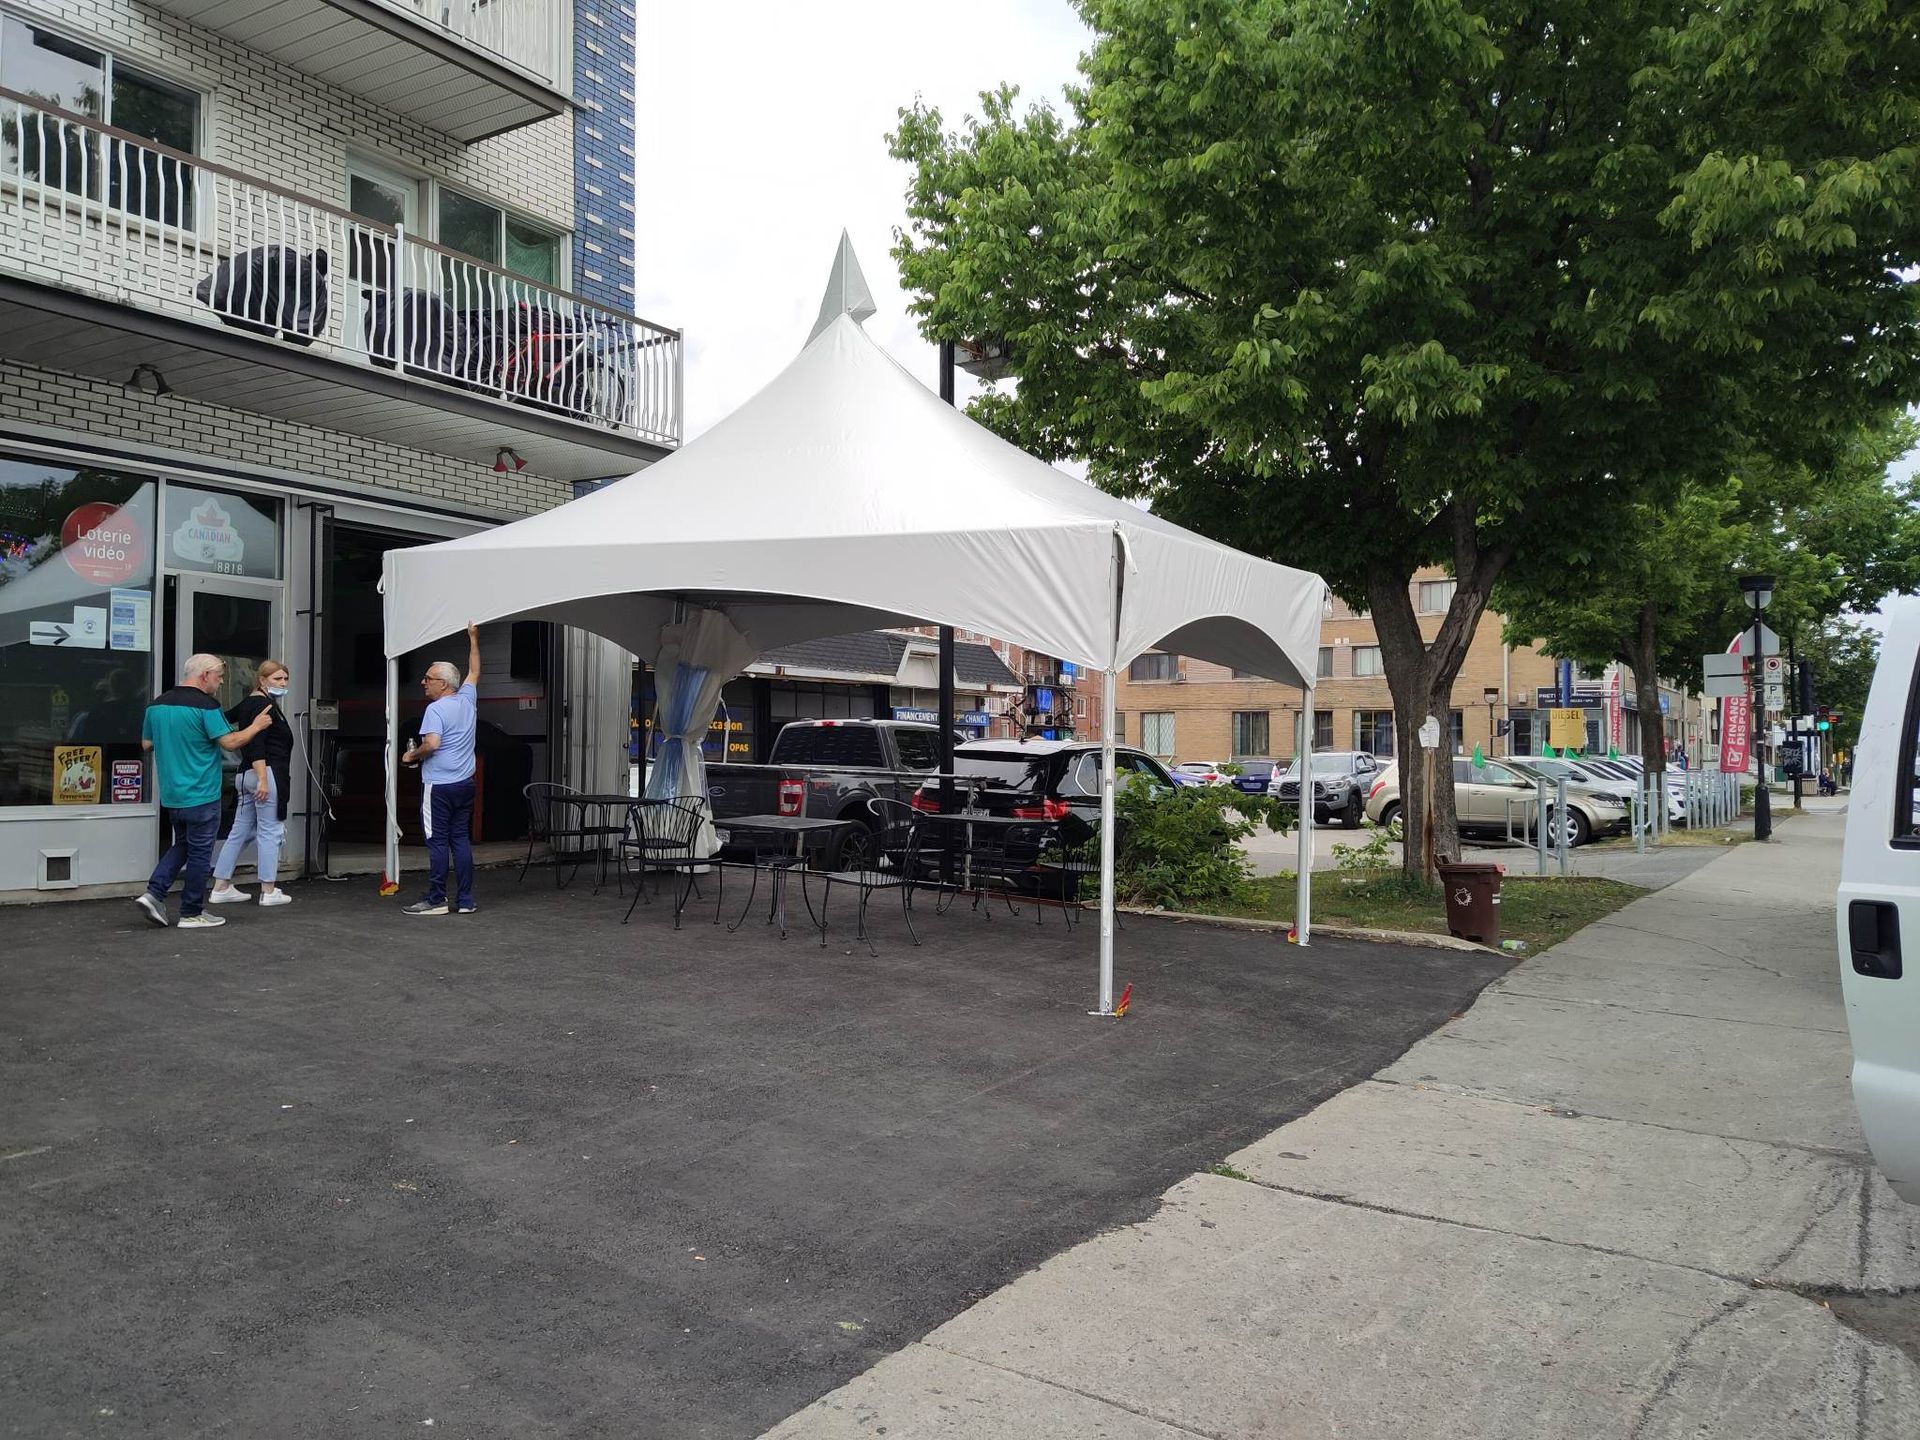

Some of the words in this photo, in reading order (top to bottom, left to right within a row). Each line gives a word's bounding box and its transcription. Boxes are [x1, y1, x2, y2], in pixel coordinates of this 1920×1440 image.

[77, 524, 131, 545] Loterie
[188, 527, 231, 544] CANADIAN
[84, 545, 125, 561] vidéo
[217, 561, 243, 575] 8818
[896, 711, 938, 721] FINANCEMENT
[965, 714, 987, 724] CHANCE
[1552, 710, 1581, 720] DIESEL
[1736, 680, 1749, 746] DISPON
[708, 720, 743, 731] ccason
[1727, 697, 1739, 745] FINANC
[729, 743, 749, 752] OPAS
[58, 748, 85, 766] FREE
